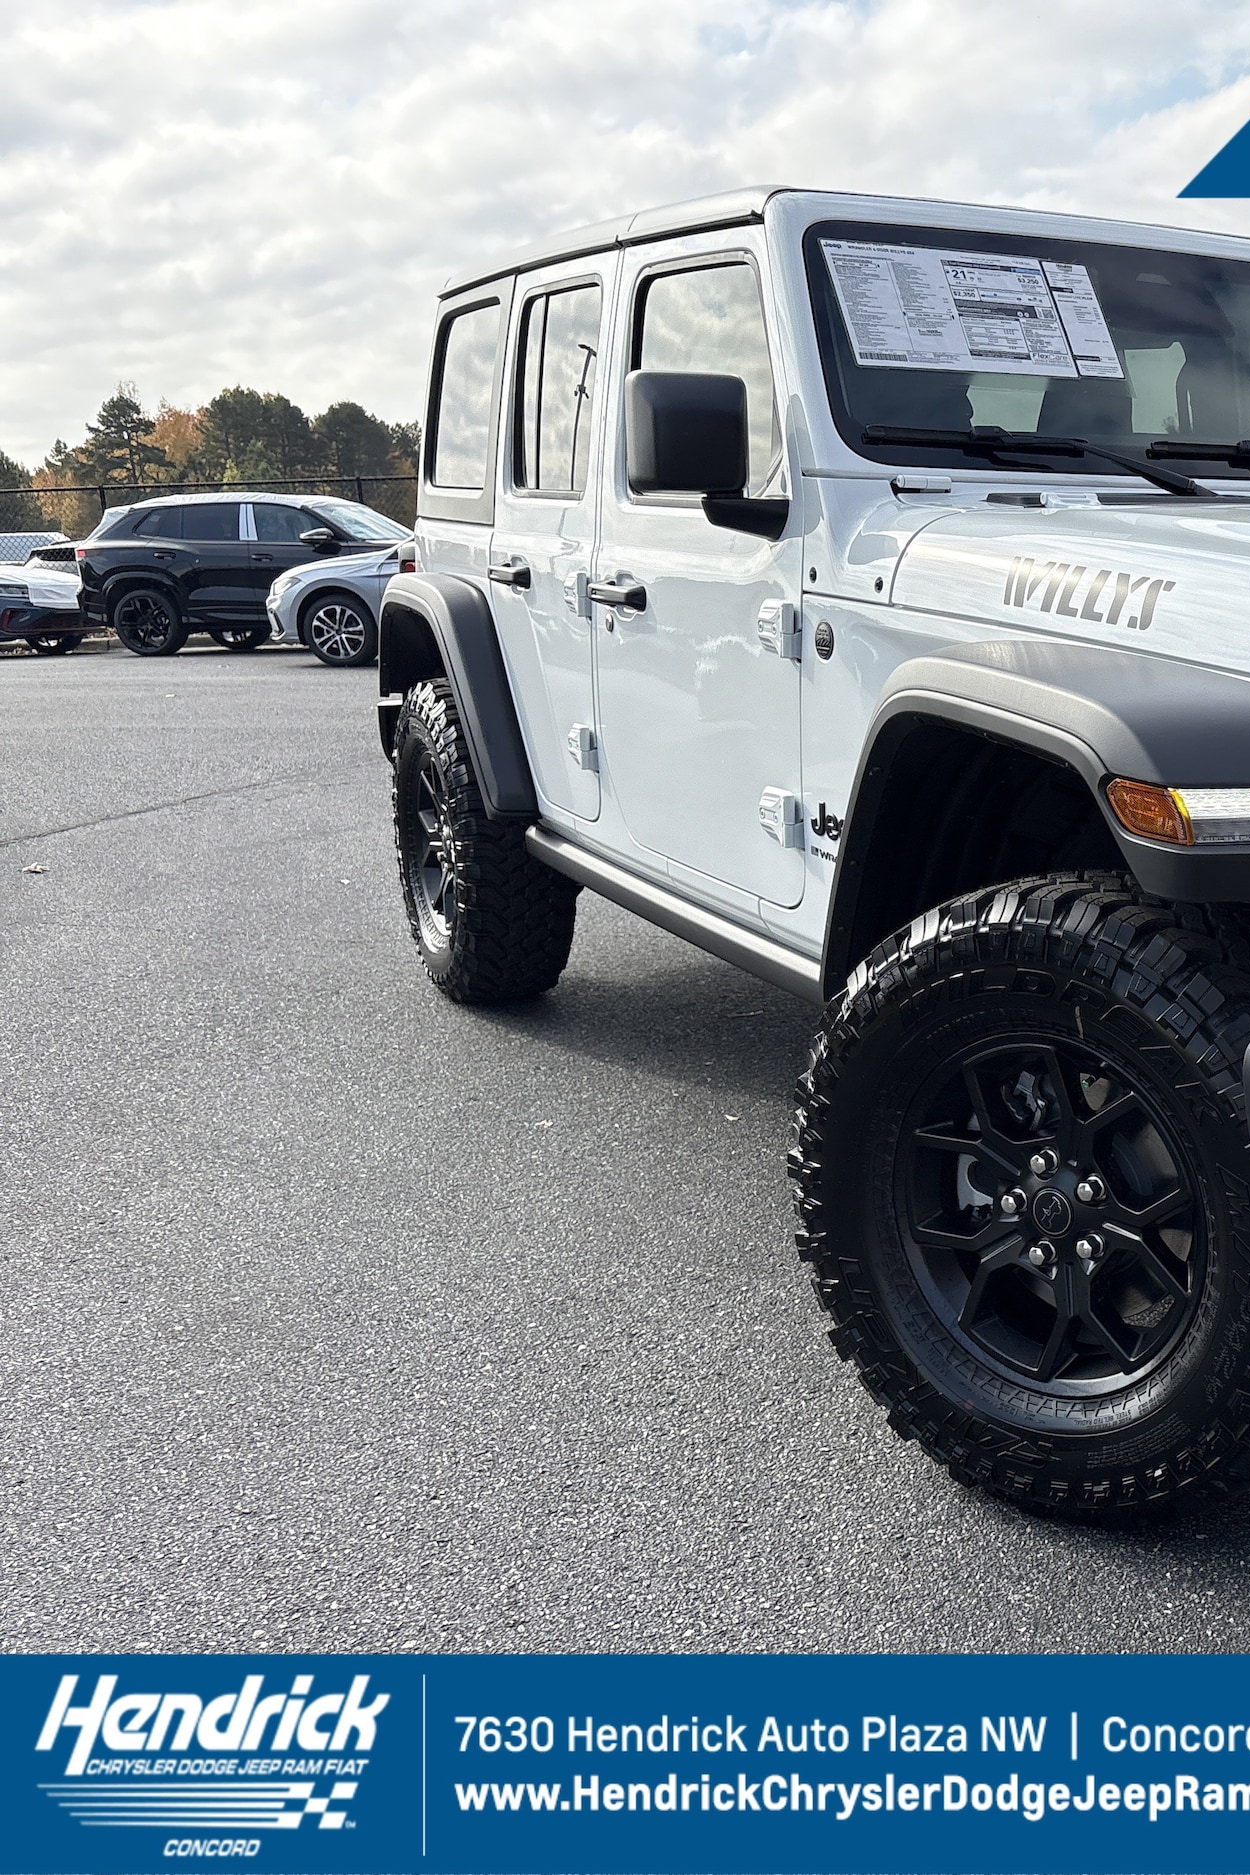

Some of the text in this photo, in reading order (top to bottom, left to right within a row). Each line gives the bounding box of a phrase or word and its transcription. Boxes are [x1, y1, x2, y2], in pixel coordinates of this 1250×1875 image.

[952, 269, 967, 280] 21
[1003, 555, 1176, 631] WILLYS
[900, 966, 1225, 1127] WILDPEAK
